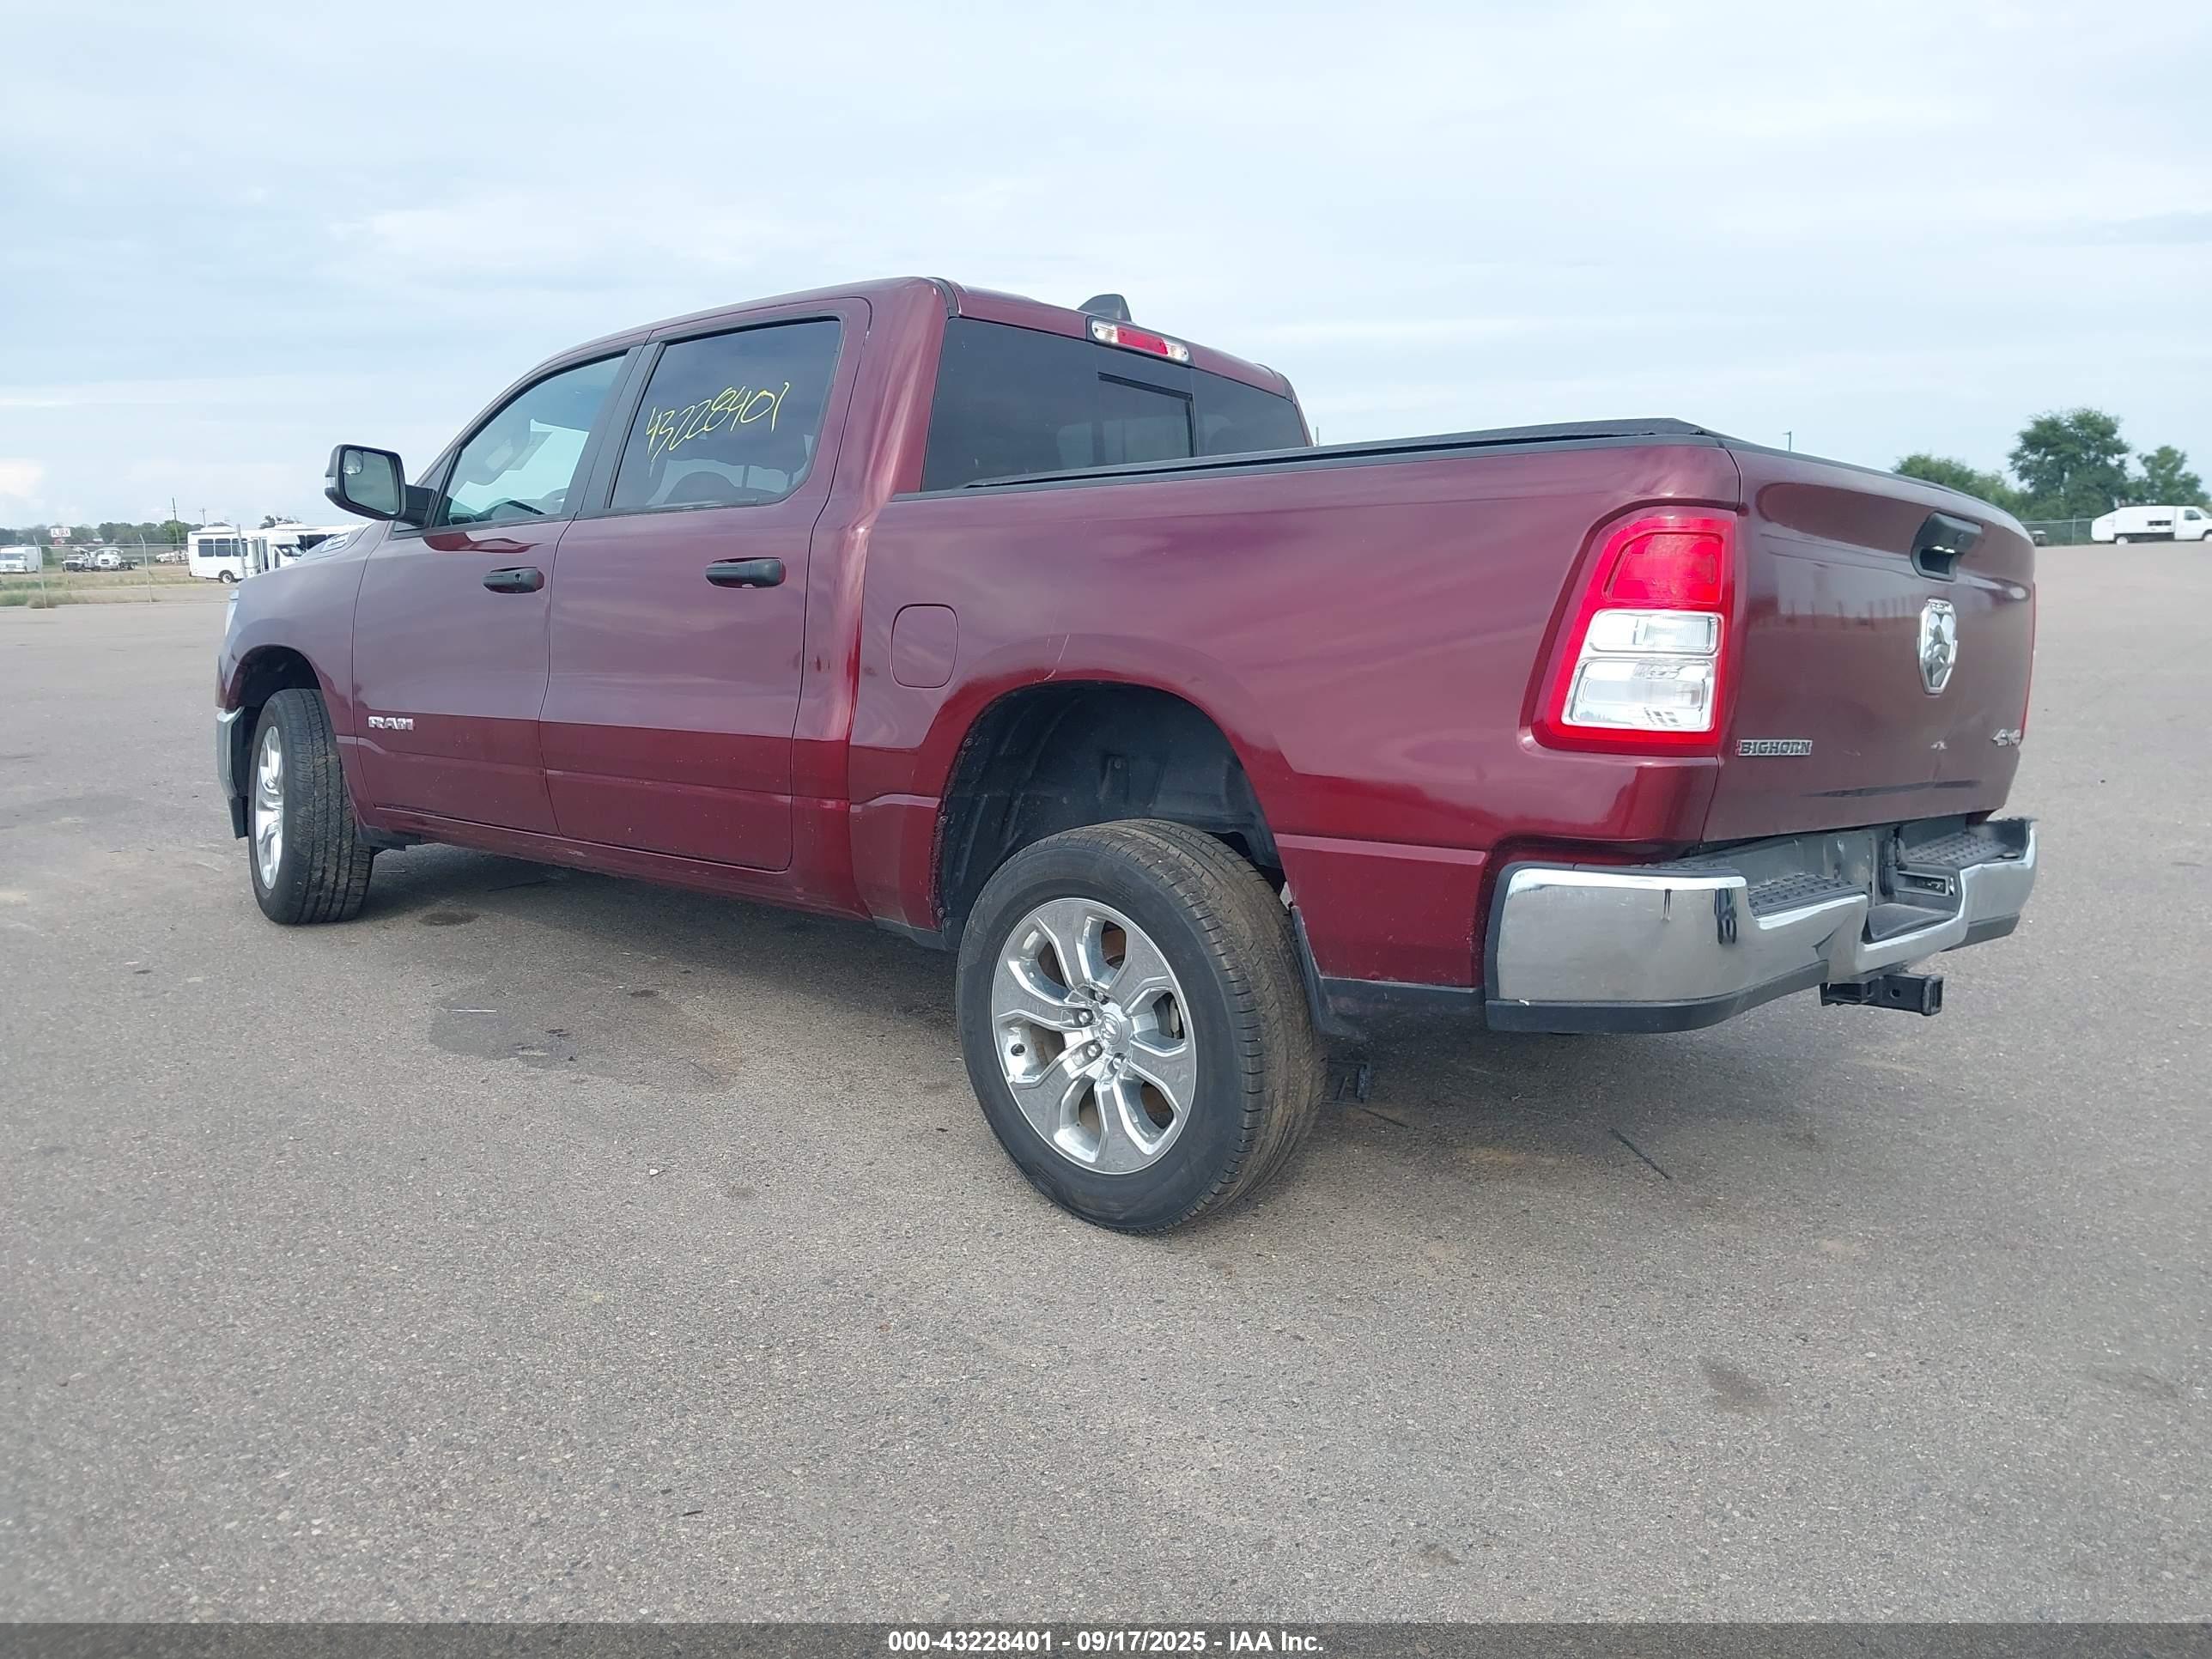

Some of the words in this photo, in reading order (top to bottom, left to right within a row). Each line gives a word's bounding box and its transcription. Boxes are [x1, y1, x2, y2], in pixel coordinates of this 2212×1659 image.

[645, 381, 790, 463] 43228401
[368, 715, 414, 731] RAM
[1736, 739, 1813, 756] BIGHORN
